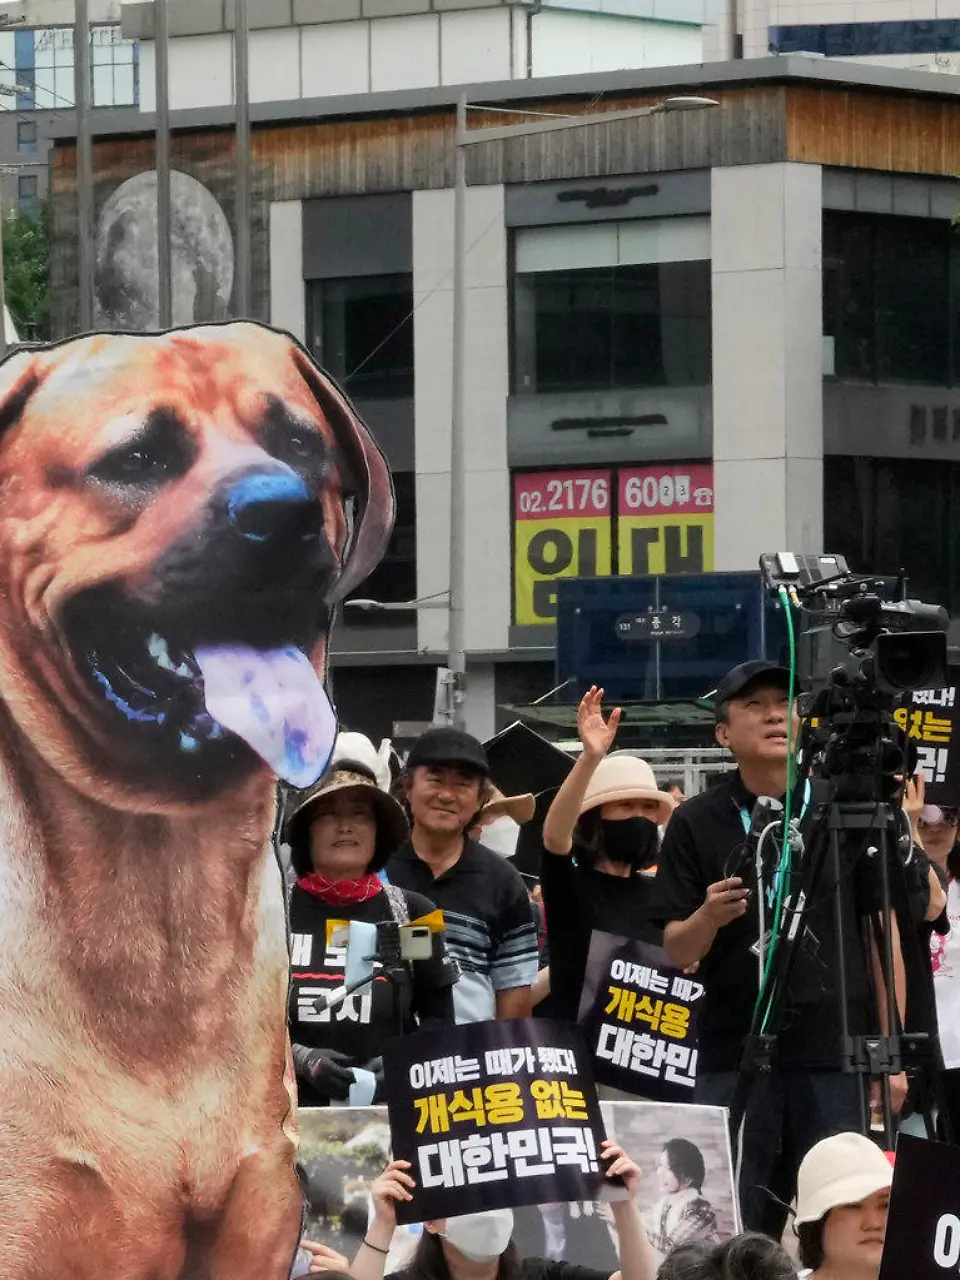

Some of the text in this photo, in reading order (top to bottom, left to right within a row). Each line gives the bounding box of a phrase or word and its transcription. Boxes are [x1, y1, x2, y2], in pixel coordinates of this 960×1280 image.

[520, 479, 608, 513] 02.2176
[610, 959, 669, 995] 이제는
[604, 985, 691, 1039] 개식용
[409, 1055, 481, 1090] 이제는
[484, 1047, 535, 1076] 때가
[595, 1022, 699, 1088] 대한민
[413, 1079, 589, 1134] 개식용 없는
[417, 1127, 600, 1189] 대한민국!
